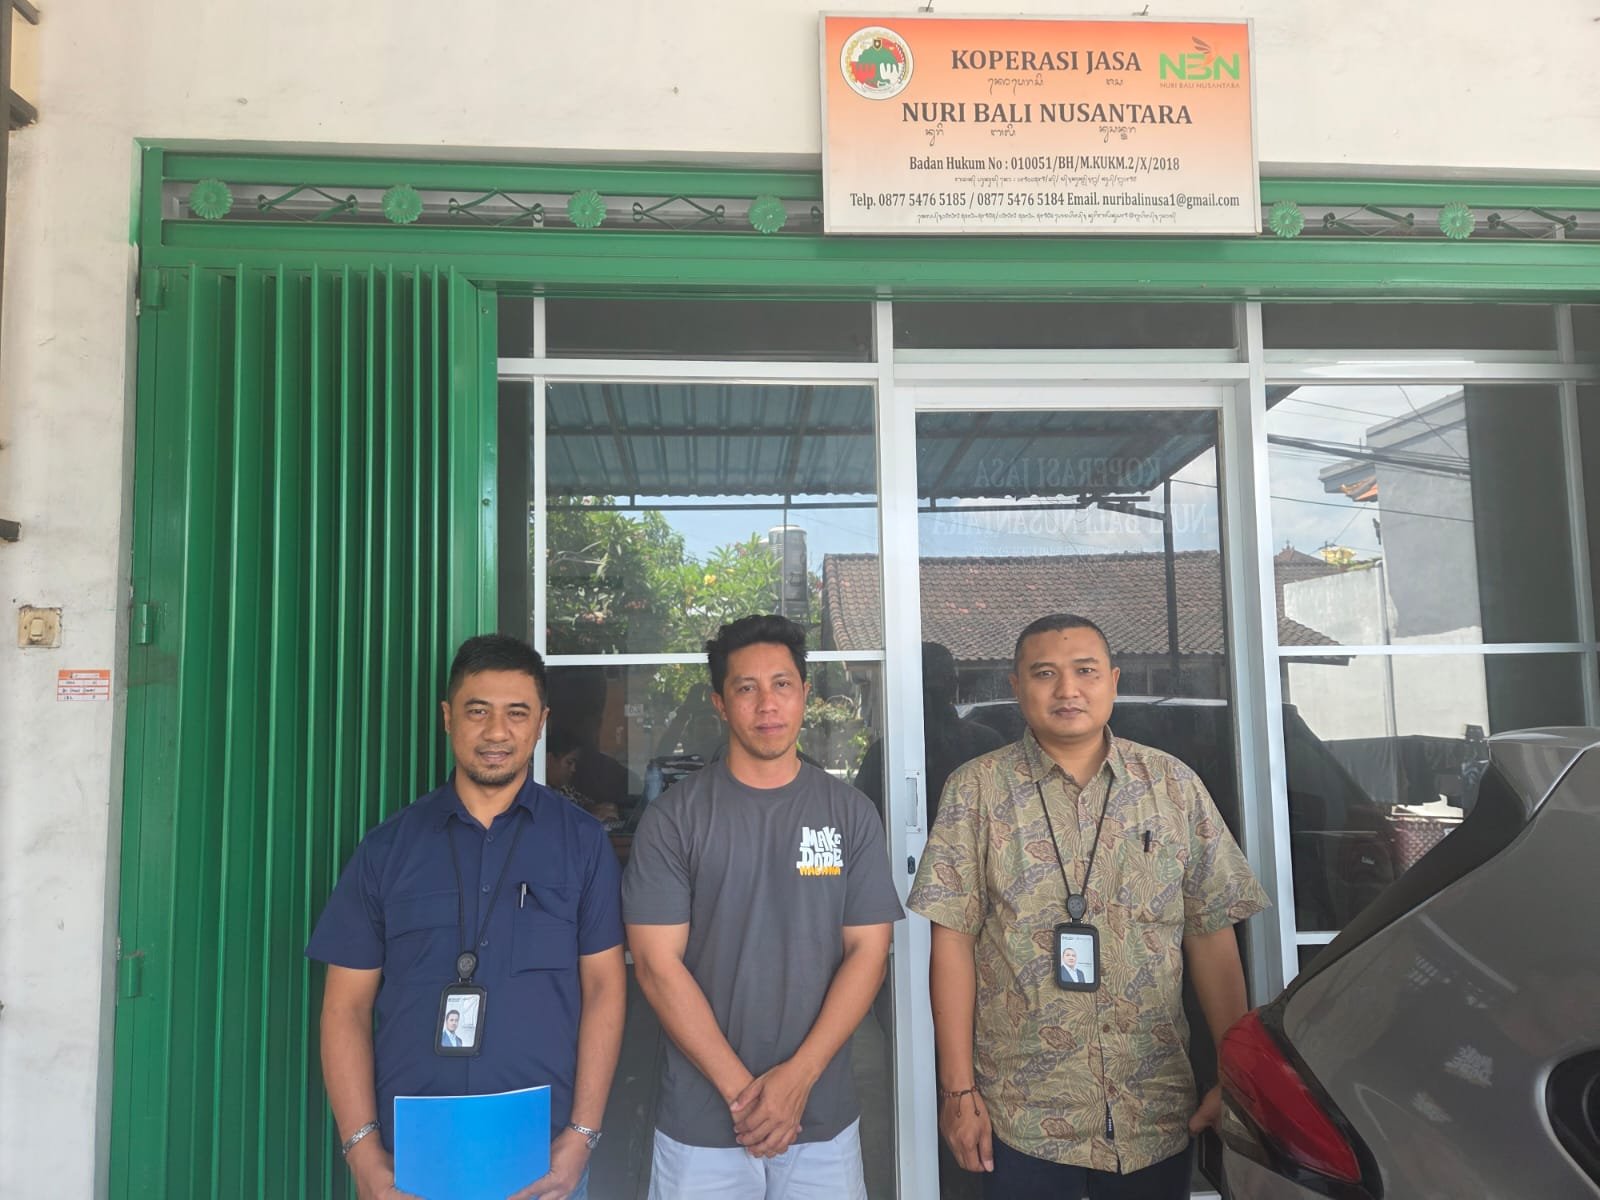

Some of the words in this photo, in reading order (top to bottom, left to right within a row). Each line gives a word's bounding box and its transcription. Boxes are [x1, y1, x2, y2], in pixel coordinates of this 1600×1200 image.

[951, 49, 1078, 71] KOPERASI
[1086, 50, 1142, 75] JASA
[902, 102, 967, 122] NURI
[973, 103, 1032, 123] BALI
[1039, 103, 1193, 125] NUSANTARA
[909, 156, 944, 170] Badan
[946, 156, 986, 170] Hukum
[988, 157, 1002, 170] No
[1011, 156, 1180, 173] 010051/BH/M.KUKM.2/X/2018
[850, 193, 876, 209] Telp.
[878, 193, 905, 207] 0877
[909, 193, 937, 207] 5476
[939, 193, 966, 206] 5185
[969, 192, 975, 209] /
[977, 193, 1004, 206] 0877
[1007, 193, 1035, 206] 5476
[1037, 192, 1064, 206] 5184
[1067, 192, 1100, 206] Email.
[1102, 193, 1240, 210] nuribalinusa1@gmail.com
